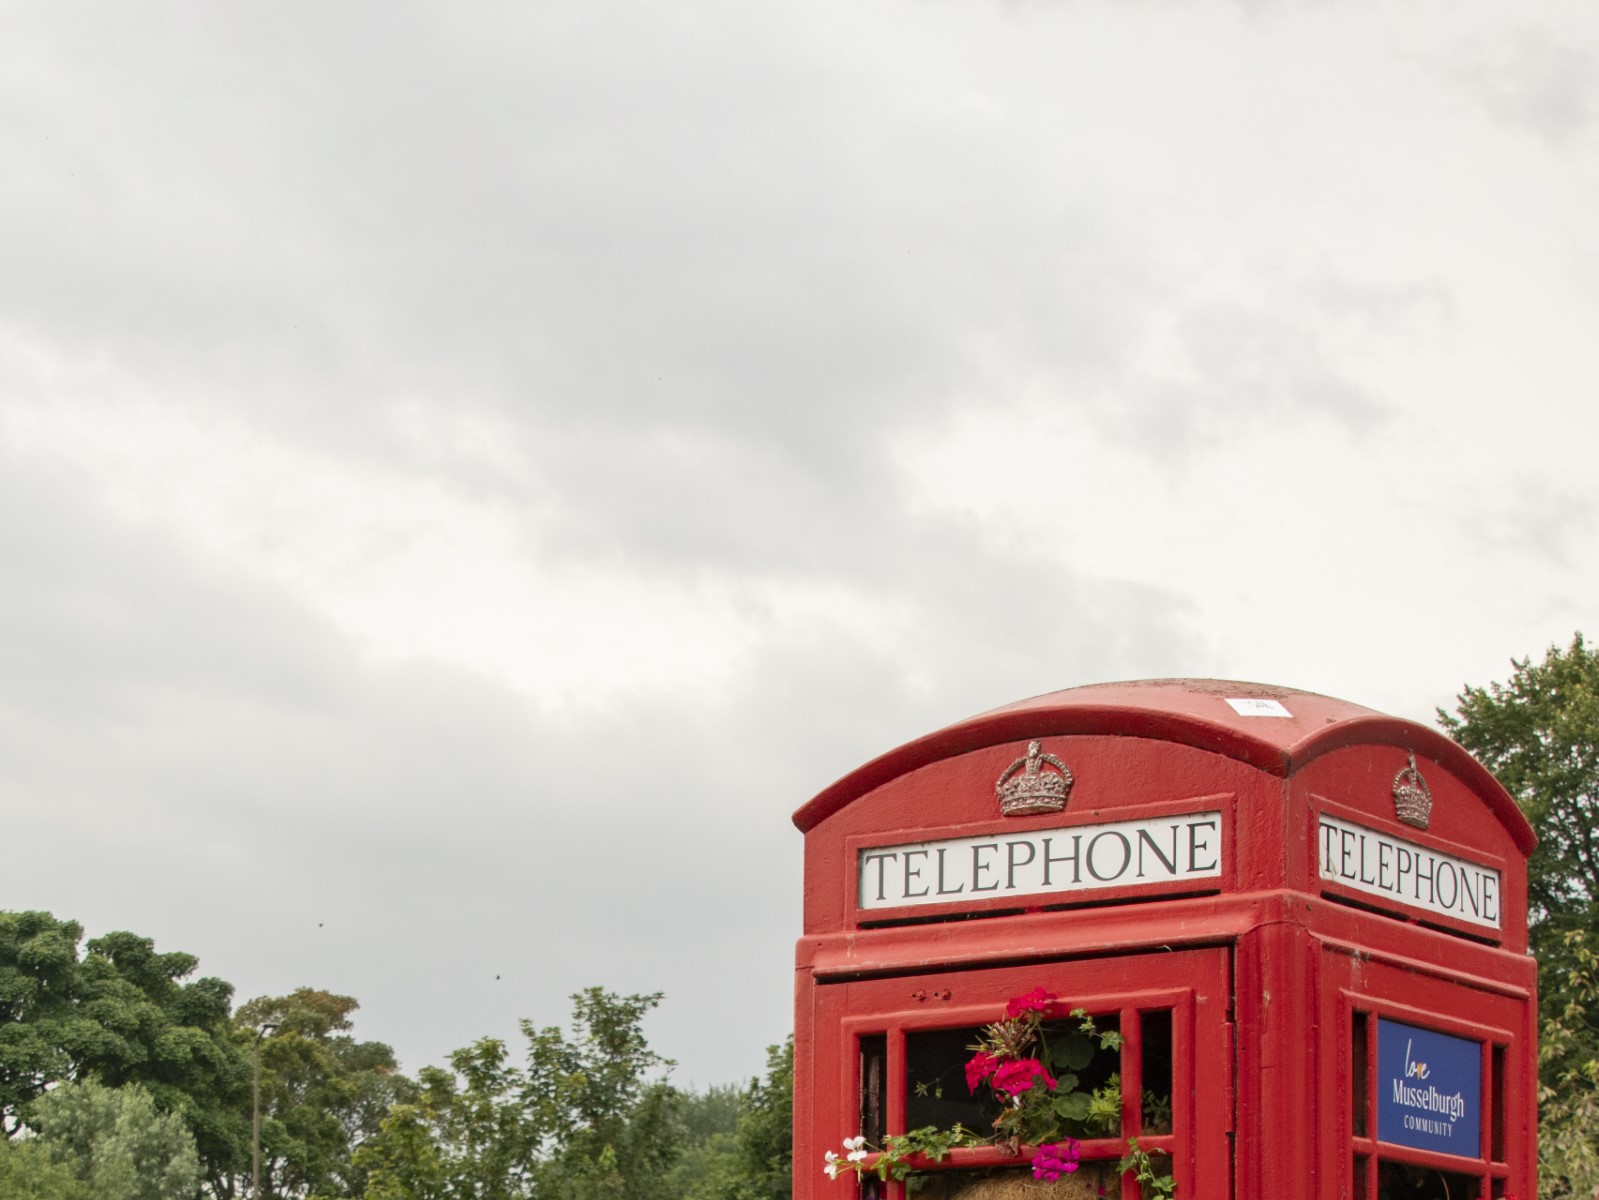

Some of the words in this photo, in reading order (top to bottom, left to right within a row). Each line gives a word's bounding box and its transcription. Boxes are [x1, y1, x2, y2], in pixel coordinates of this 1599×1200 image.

[865, 821, 1217, 900] TELEPHONE
[1320, 822, 1497, 922] TELEPHONE
[1405, 1038, 1430, 1080] love
[1393, 1078, 1464, 1122] Musselburgh
[1404, 1114, 1453, 1137] COMMUNITY
